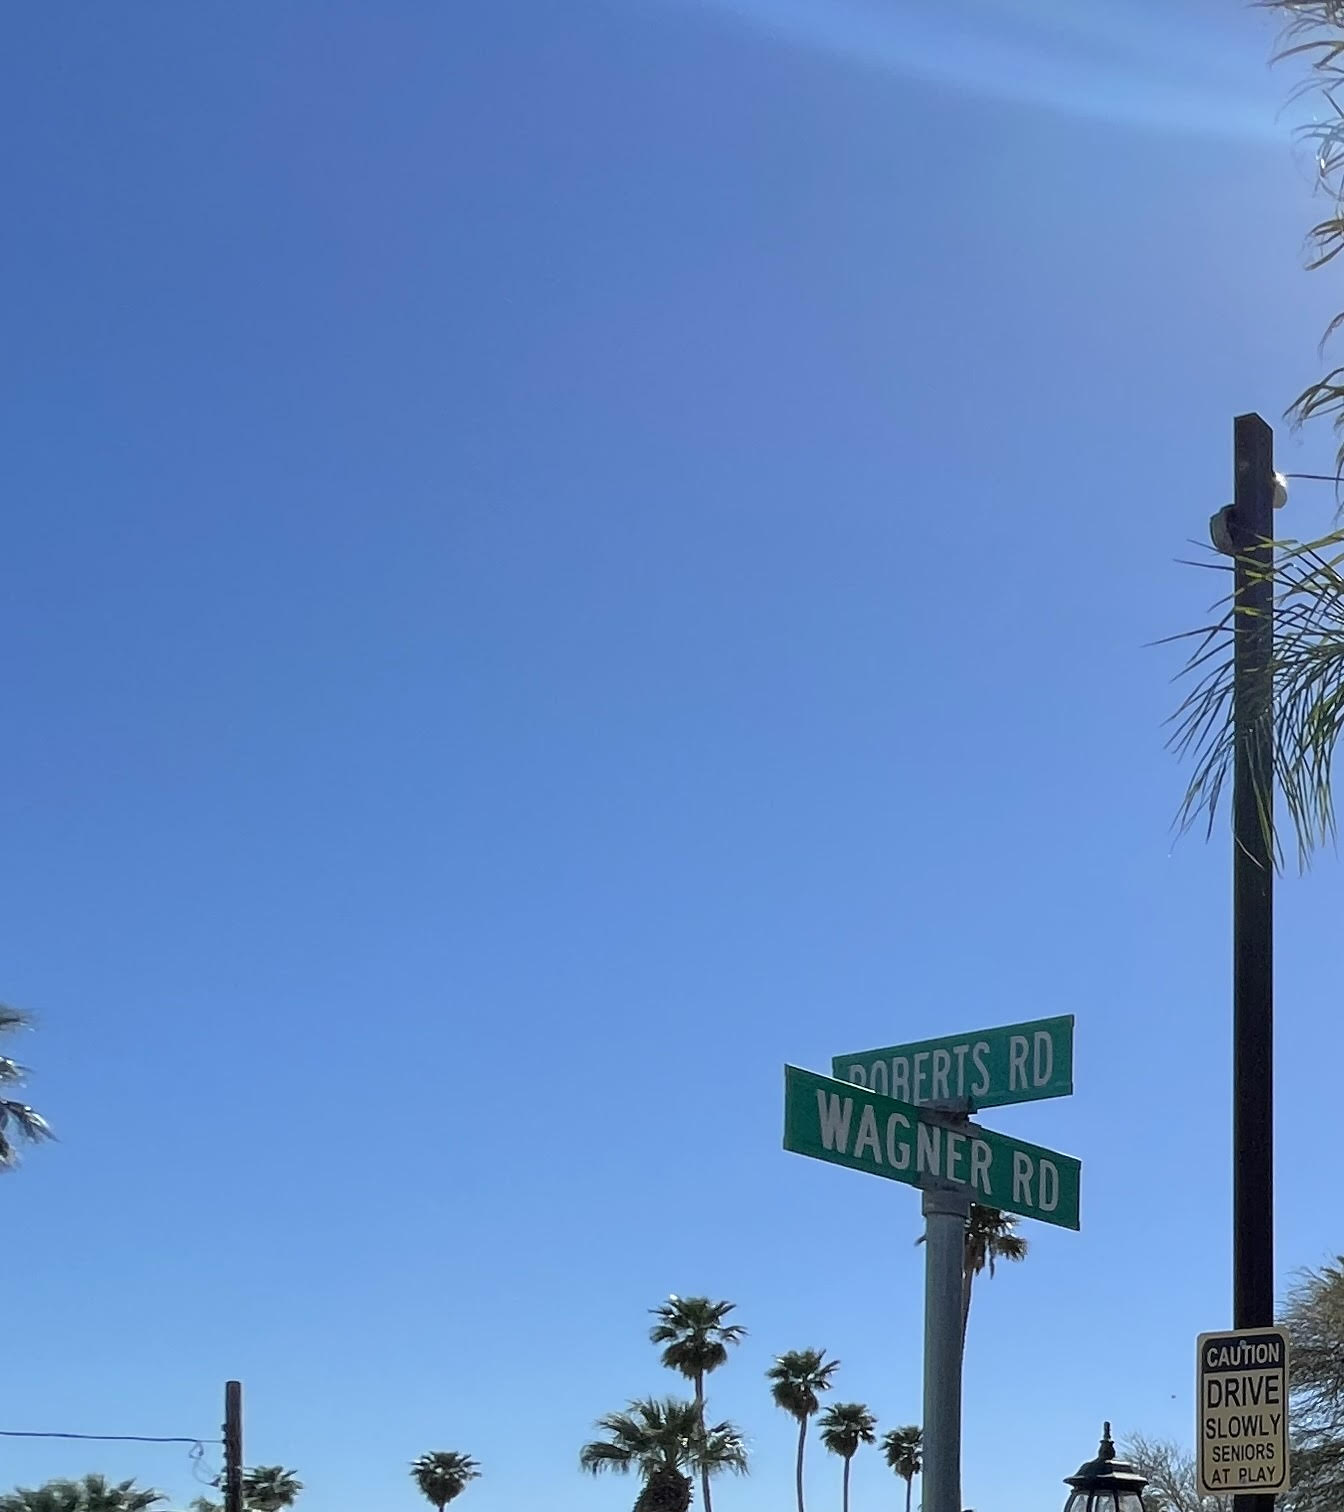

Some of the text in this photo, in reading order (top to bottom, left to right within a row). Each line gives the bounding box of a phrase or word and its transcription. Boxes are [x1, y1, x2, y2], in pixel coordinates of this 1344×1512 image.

[1009, 1031, 1054, 1092] RD
[816, 1088, 1060, 1212] WAGNER RD
[1206, 1342, 1280, 1368] CAUTION
[1207, 1375, 1280, 1409] DRIVE
[1205, 1413, 1281, 1440] SLOWLY
[1212, 1443, 1275, 1463] SENIORS
[1211, 1466, 1276, 1485] AT PLAY
